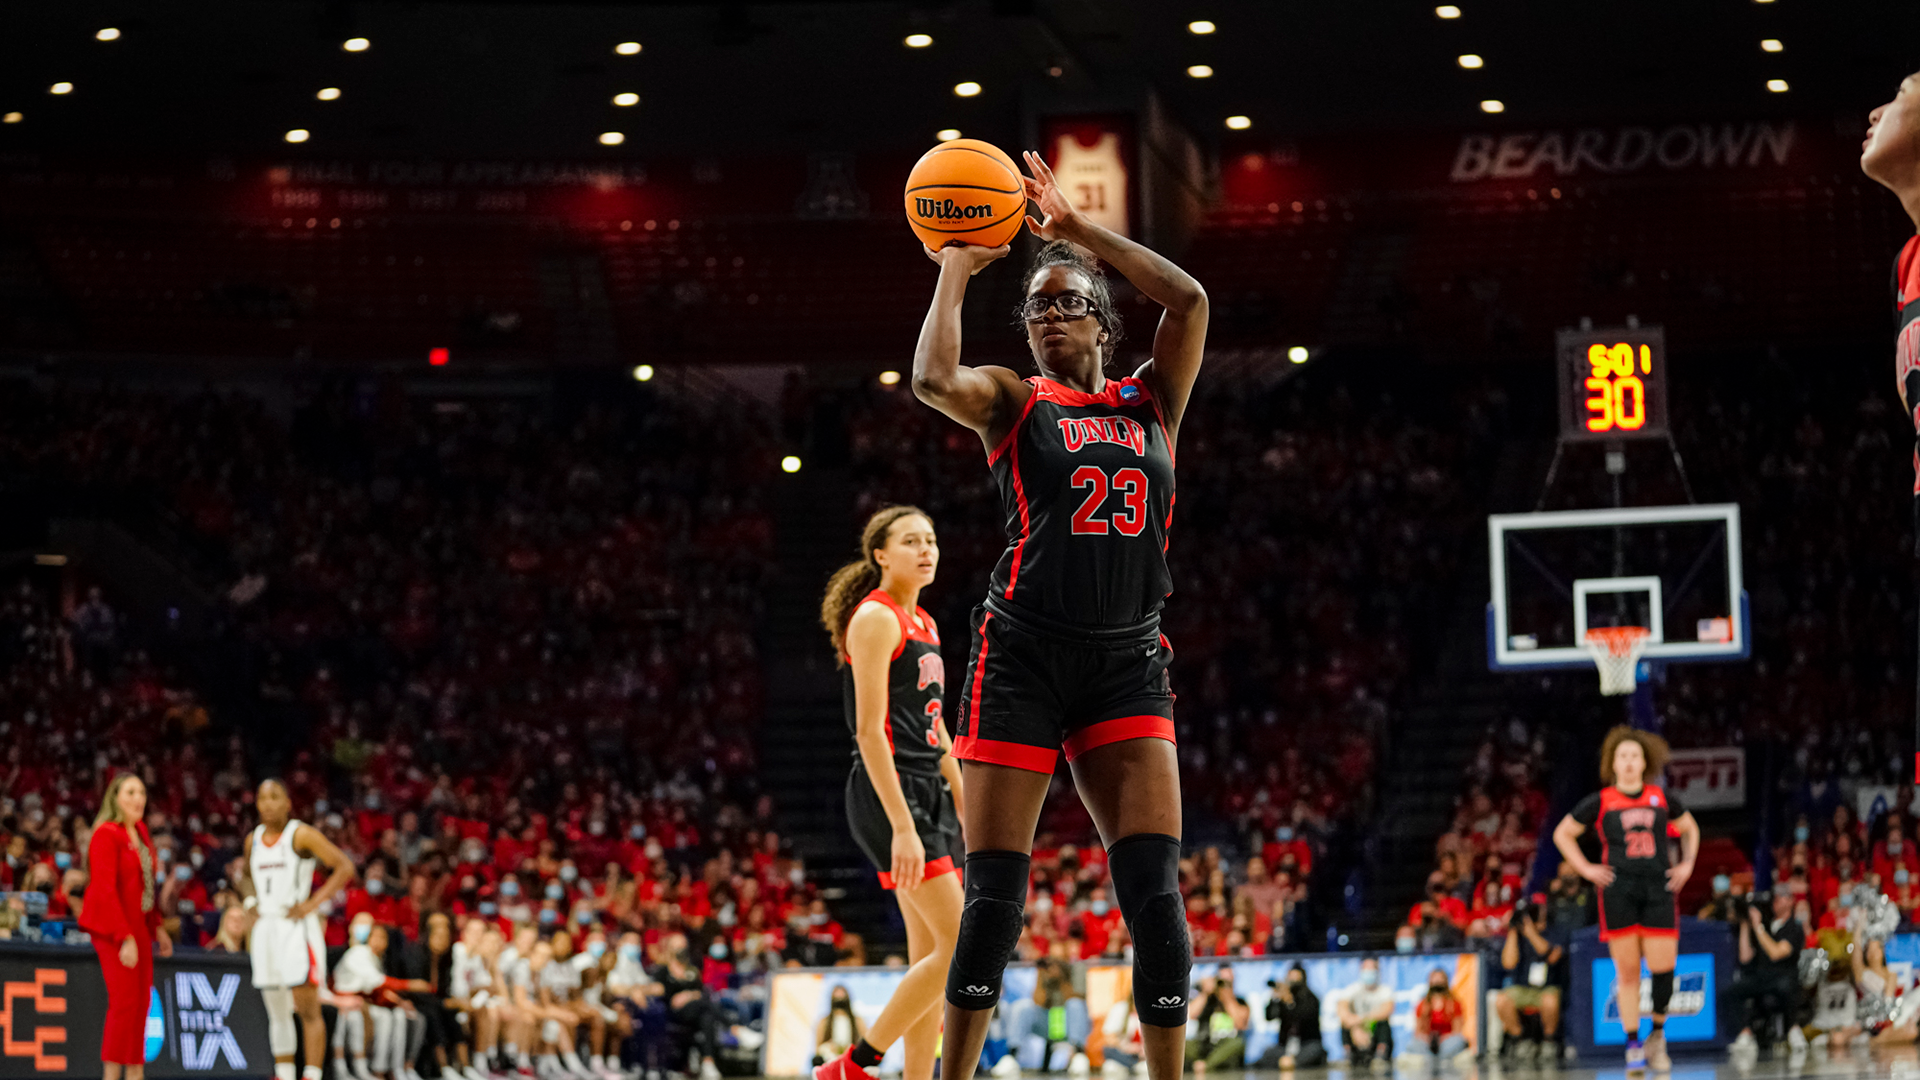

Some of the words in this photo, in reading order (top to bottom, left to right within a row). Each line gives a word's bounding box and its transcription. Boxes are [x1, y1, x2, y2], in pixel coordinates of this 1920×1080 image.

[915, 197, 993, 219] Wilson
[1076, 182, 1106, 211] 31
[1588, 342, 1651, 379] 5:01
[1584, 375, 1645, 432] 30
[1056, 415, 1147, 457] UNLV
[1070, 465, 1149, 537] 23
